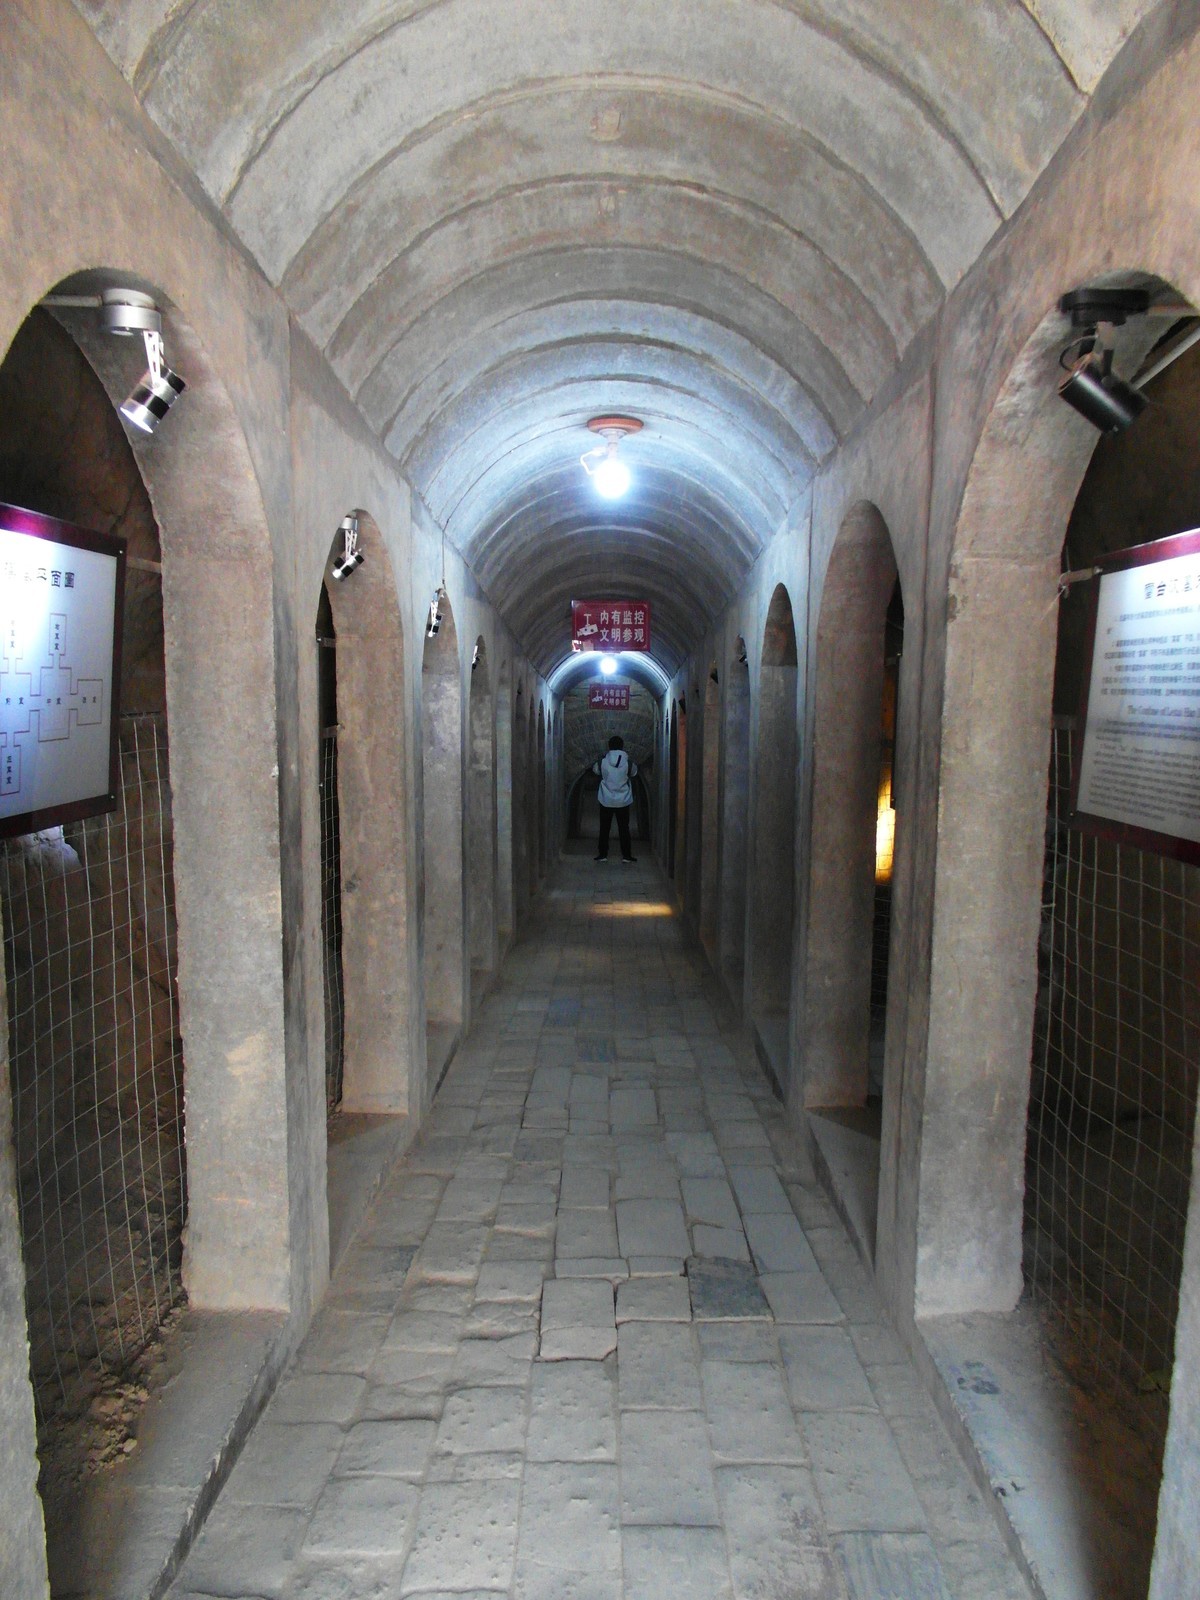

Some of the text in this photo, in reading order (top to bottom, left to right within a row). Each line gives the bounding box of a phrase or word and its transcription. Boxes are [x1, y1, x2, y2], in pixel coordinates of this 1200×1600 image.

[600, 610, 645, 625] 内有监控
[600, 628, 645, 642] 文明参观
